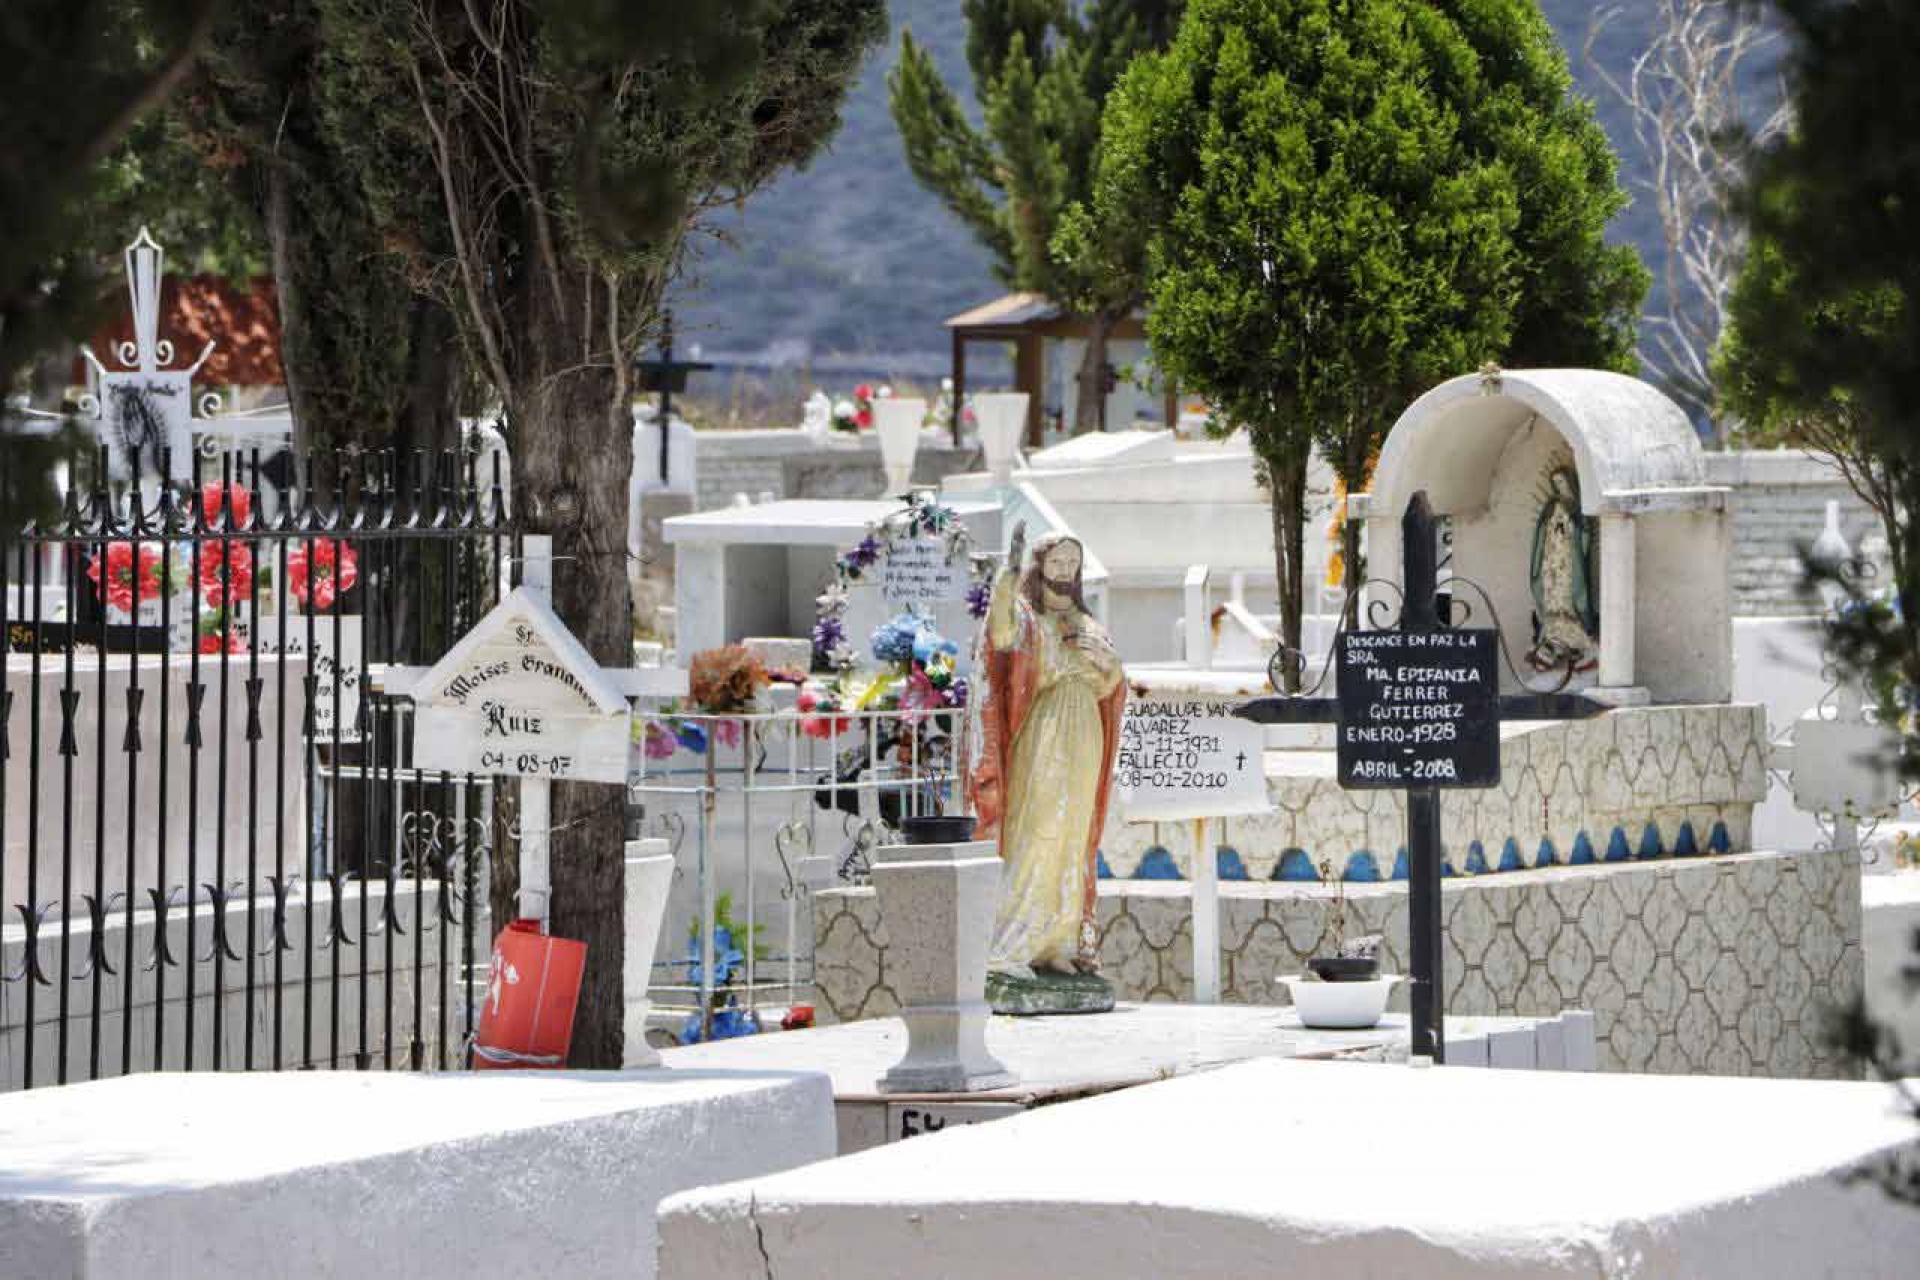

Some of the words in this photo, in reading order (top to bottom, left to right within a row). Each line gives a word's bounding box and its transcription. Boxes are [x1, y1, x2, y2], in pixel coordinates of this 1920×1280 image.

[1407, 635, 1426, 647] EN
[1430, 635, 1452, 647] PAZ
[1459, 635, 1477, 647] LA
[1397, 666, 1480, 682] EPIFANIA
[1383, 685, 1448, 701] FERRER
[481, 701, 541, 737] Ruiz
[1369, 703, 1464, 720] GUTIERREZ
[1123, 719, 1190, 735] ALVAREZ
[1118, 751, 1199, 769] FALLECIO
